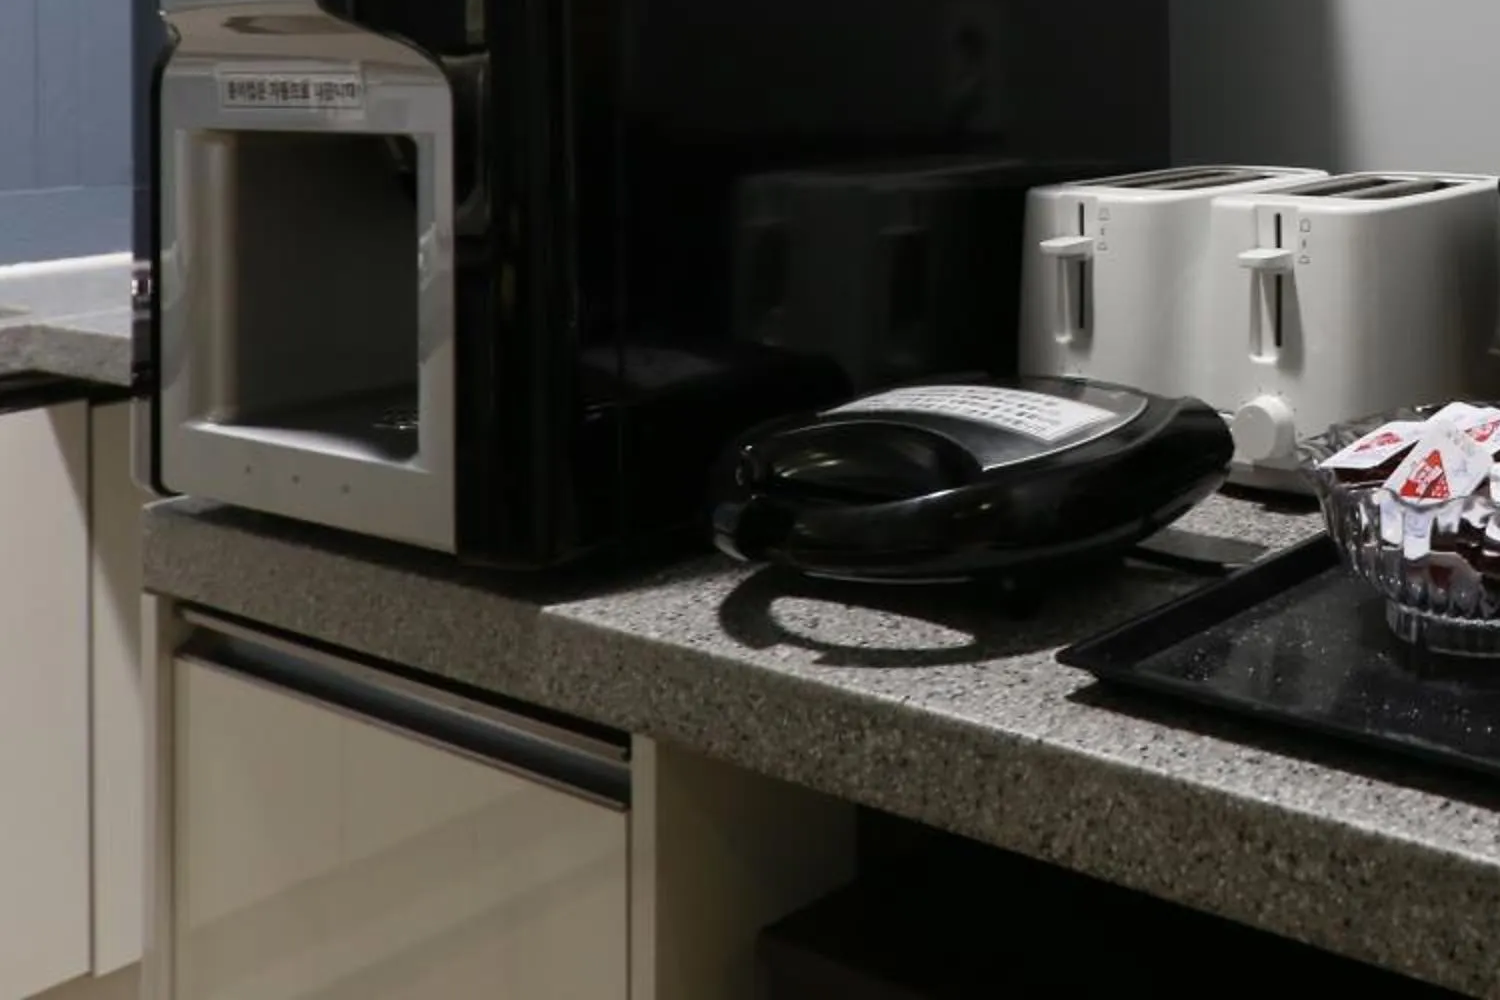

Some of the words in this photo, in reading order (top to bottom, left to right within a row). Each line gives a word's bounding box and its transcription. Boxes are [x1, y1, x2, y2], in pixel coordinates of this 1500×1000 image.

[227, 79, 268, 102] 종이컵은
[269, 78, 311, 103] 자동으로
[314, 80, 356, 102] 나옵니다
